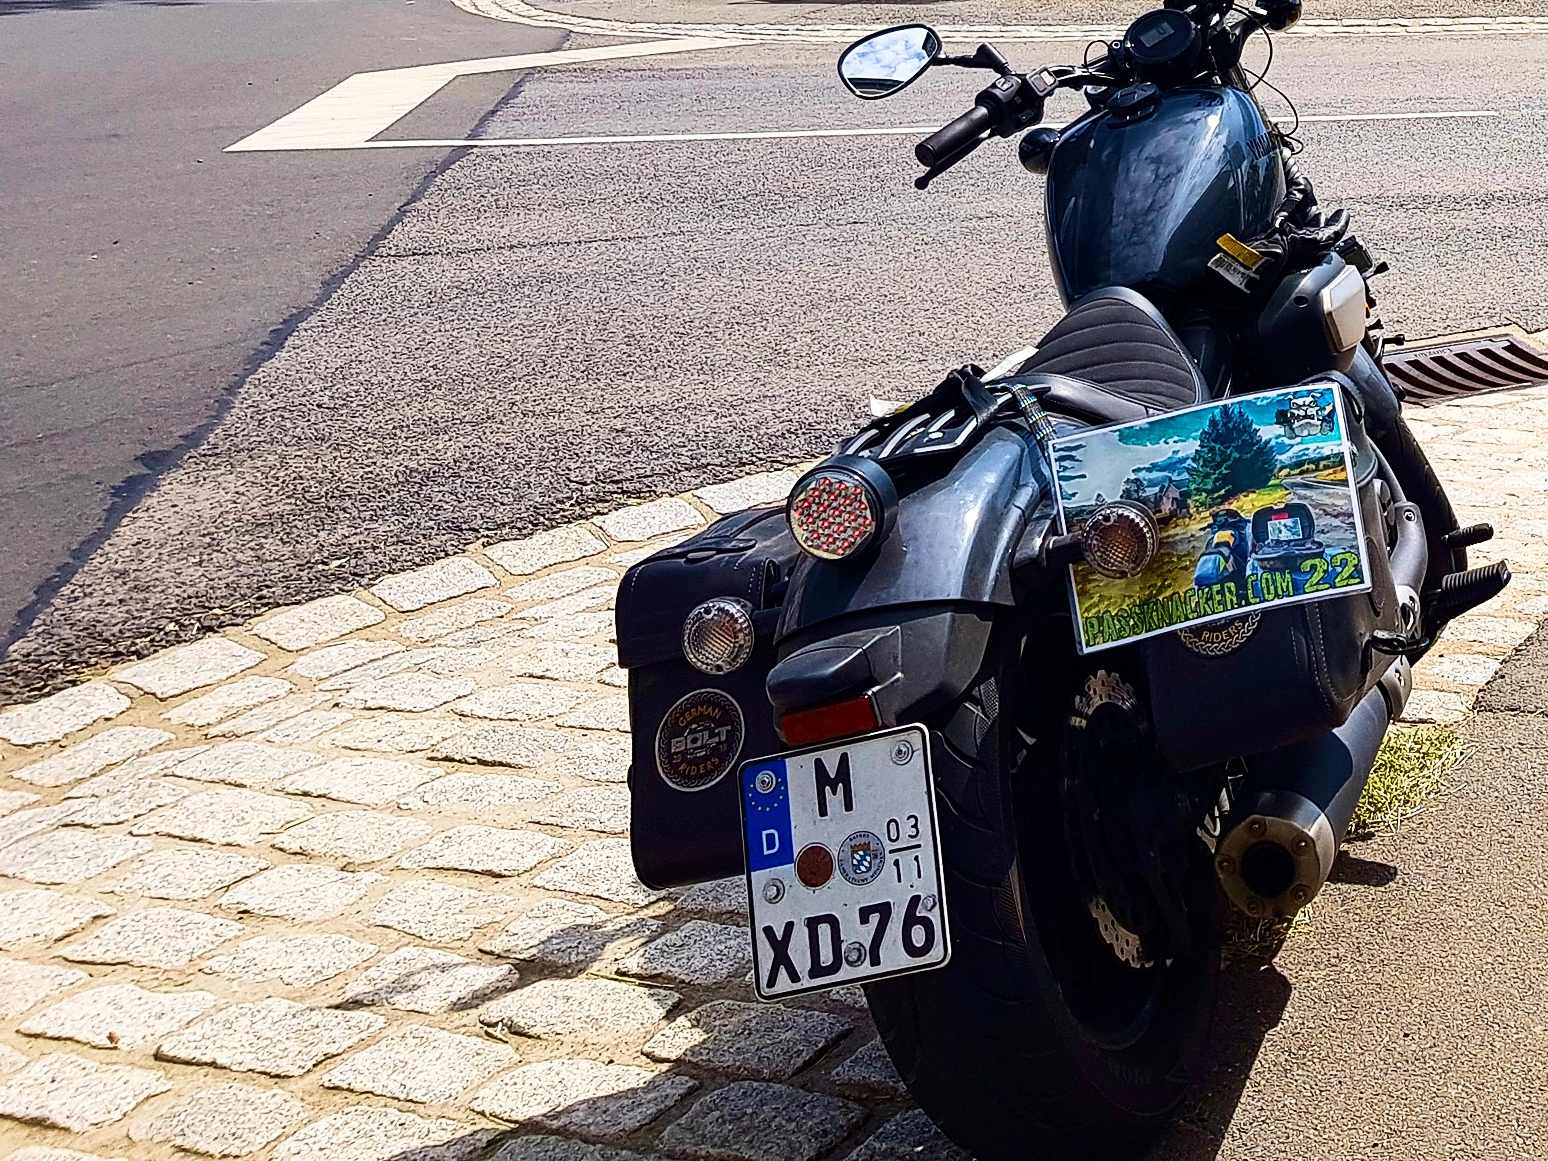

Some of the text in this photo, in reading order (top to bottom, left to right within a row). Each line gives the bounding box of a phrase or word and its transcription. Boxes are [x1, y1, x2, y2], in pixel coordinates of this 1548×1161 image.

[1085, 552, 1362, 647] PASSKNACKER.COM 22
[1201, 620, 1243, 642] RIDERS
[678, 704, 722, 727] GERMAN
[671, 725, 732, 753] BOLT
[679, 757, 719, 776] RIDERS
[813, 752, 854, 818] M
[762, 829, 780, 856] D
[886, 814, 920, 843] 03
[892, 855, 922, 884] 11
